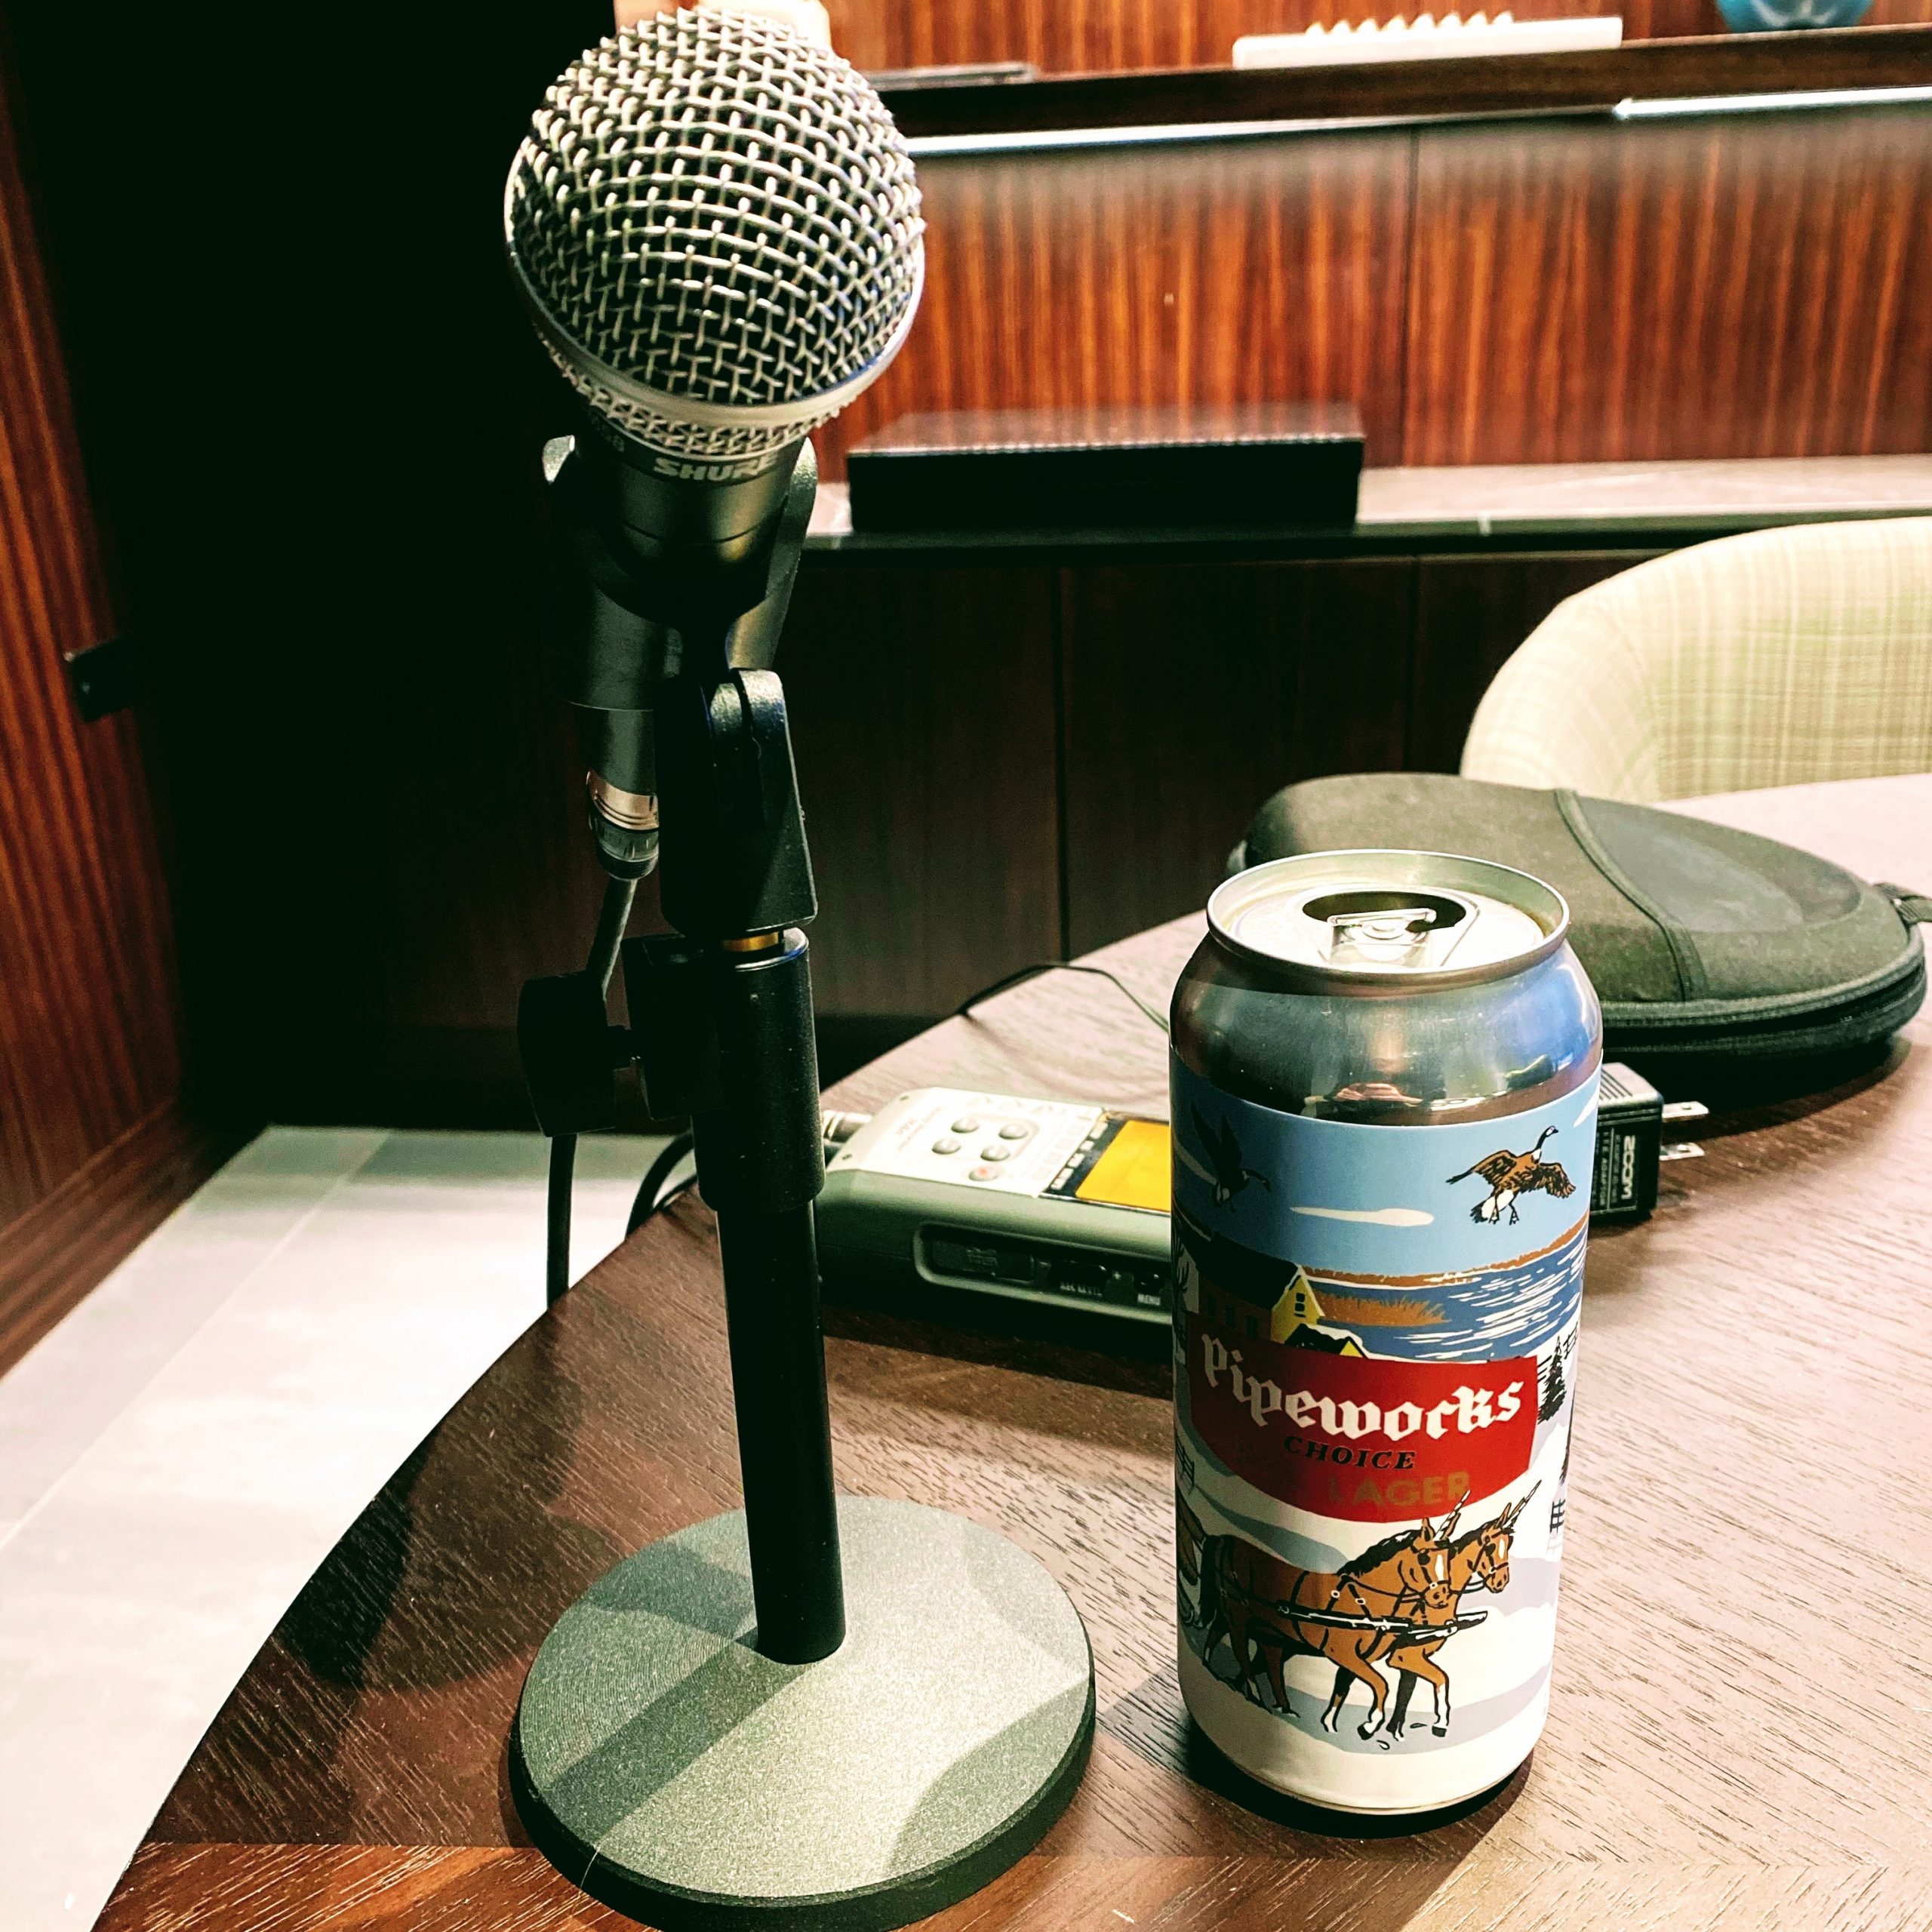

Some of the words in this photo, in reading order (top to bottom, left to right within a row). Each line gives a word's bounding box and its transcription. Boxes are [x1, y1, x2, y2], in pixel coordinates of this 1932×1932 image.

[654, 454, 778, 481] SHURE
[1621, 1135, 1635, 1199] ZOOM
[1201, 1334, 1524, 1441] Pipeworks
[1284, 1435, 1416, 1469] CHOICE
[1329, 1471, 1470, 1507] LAGER
